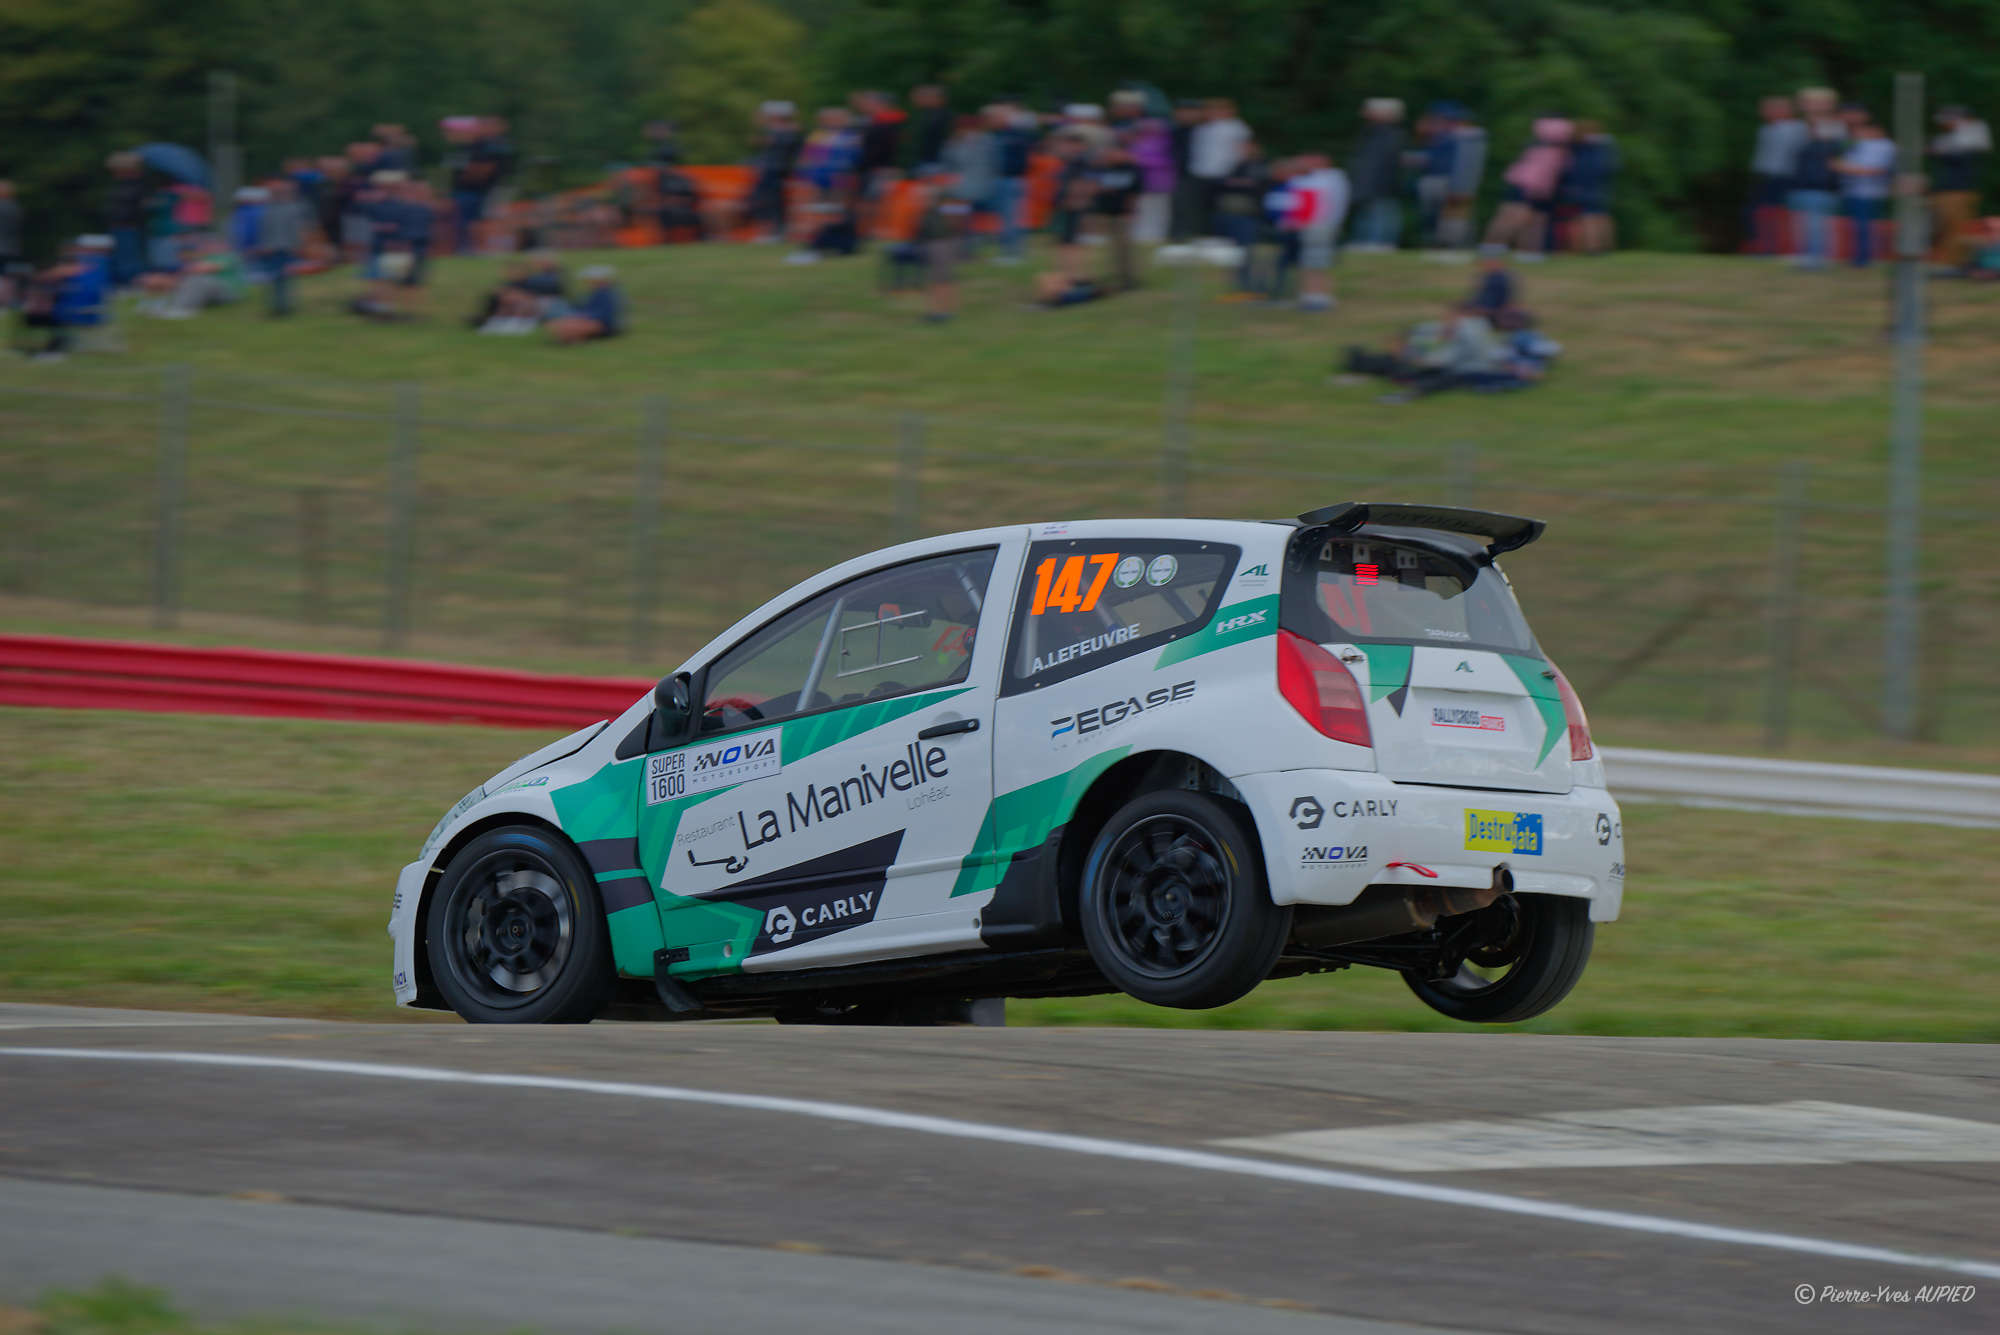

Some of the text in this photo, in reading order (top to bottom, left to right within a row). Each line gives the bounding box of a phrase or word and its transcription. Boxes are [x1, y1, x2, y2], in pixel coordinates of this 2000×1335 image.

[1031, 553, 1119, 615] 147
[1032, 623, 1141, 673] A.LEFEUVRE
[1050, 680, 1195, 740] PEGASE
[651, 753, 685, 775] SUPER
[694, 738, 775, 772] NOVA
[651, 774, 685, 800] 1600
[738, 741, 949, 850] La Manivelle
[1333, 799, 1398, 818] CARLY
[1301, 845, 1368, 860] NOVA
[802, 891, 874, 926] CARLY
